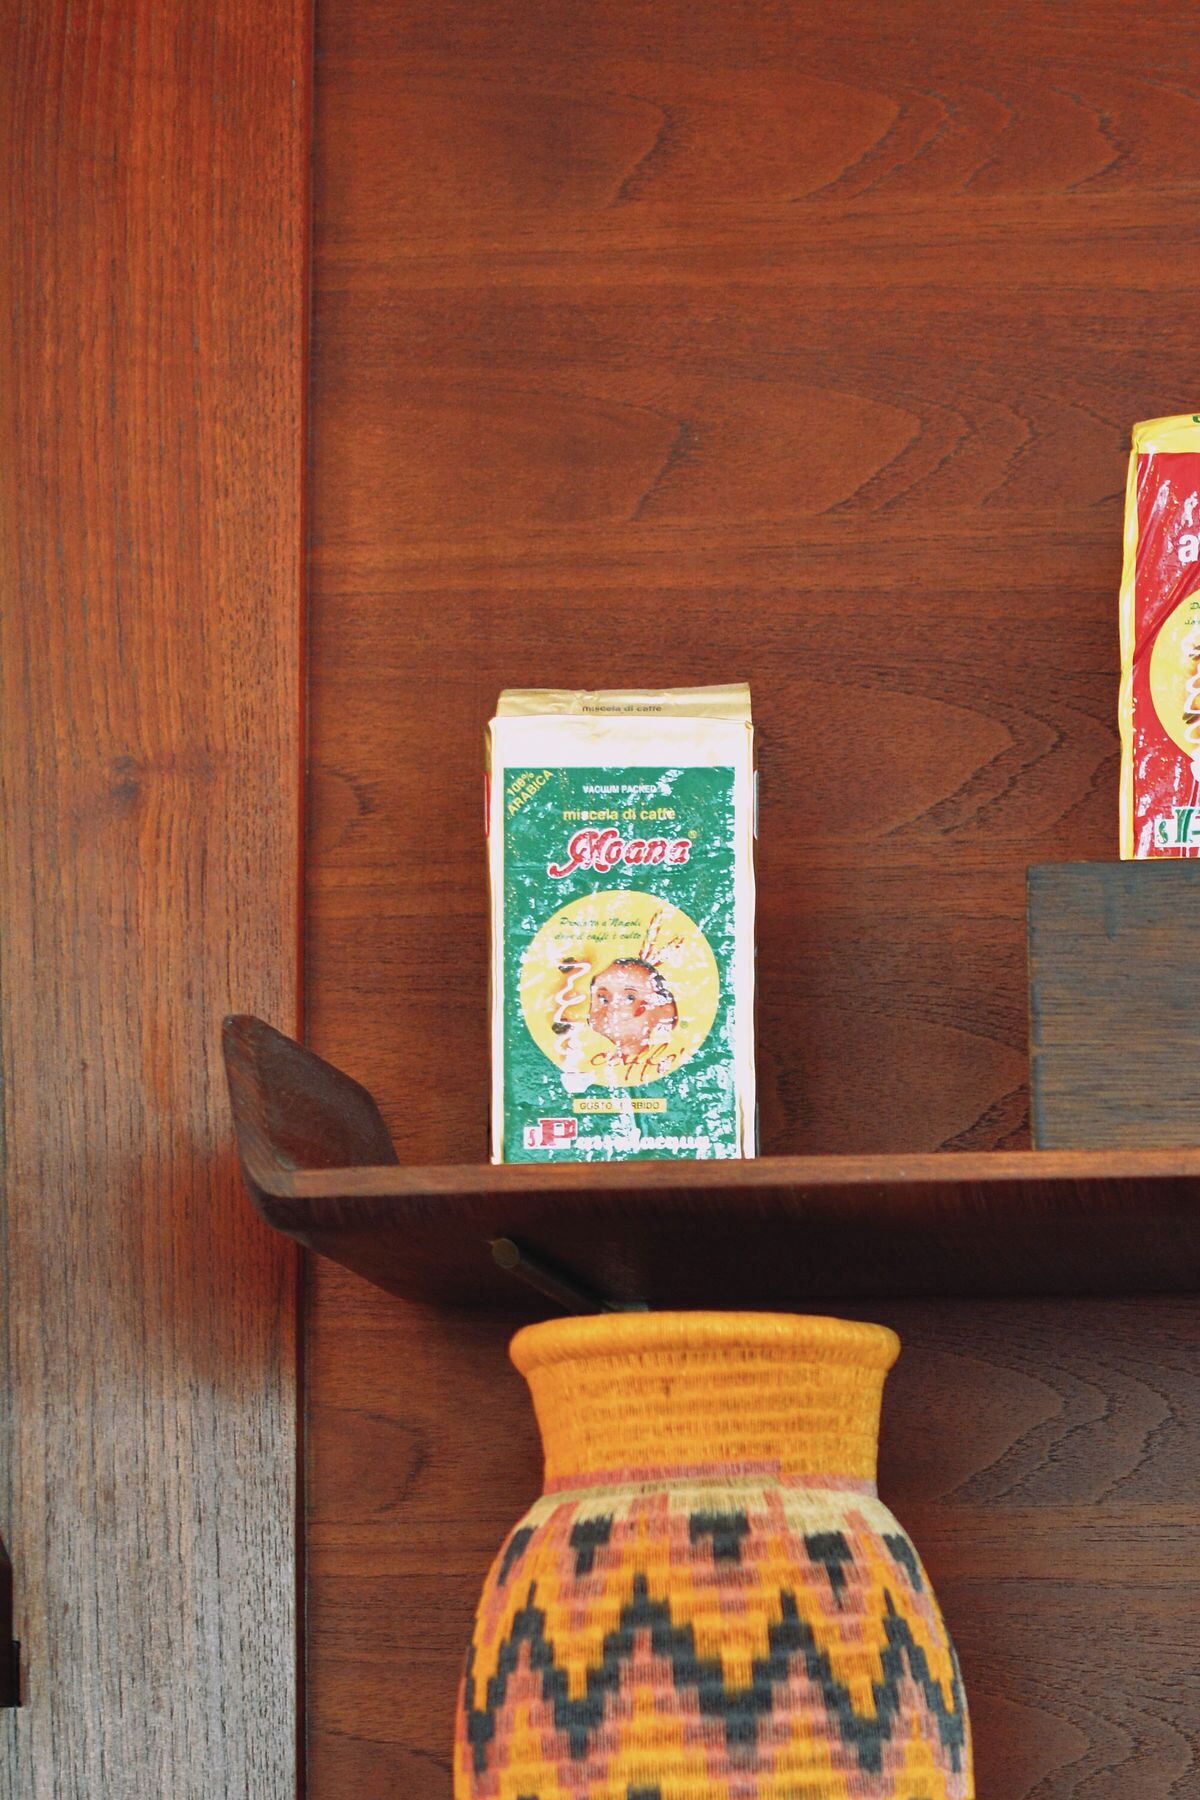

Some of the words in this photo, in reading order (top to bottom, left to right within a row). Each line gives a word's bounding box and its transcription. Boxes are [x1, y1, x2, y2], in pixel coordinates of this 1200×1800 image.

[508, 769, 554, 816] ARABICA
[563, 808, 619, 821] miscela
[622, 807, 637, 821] di
